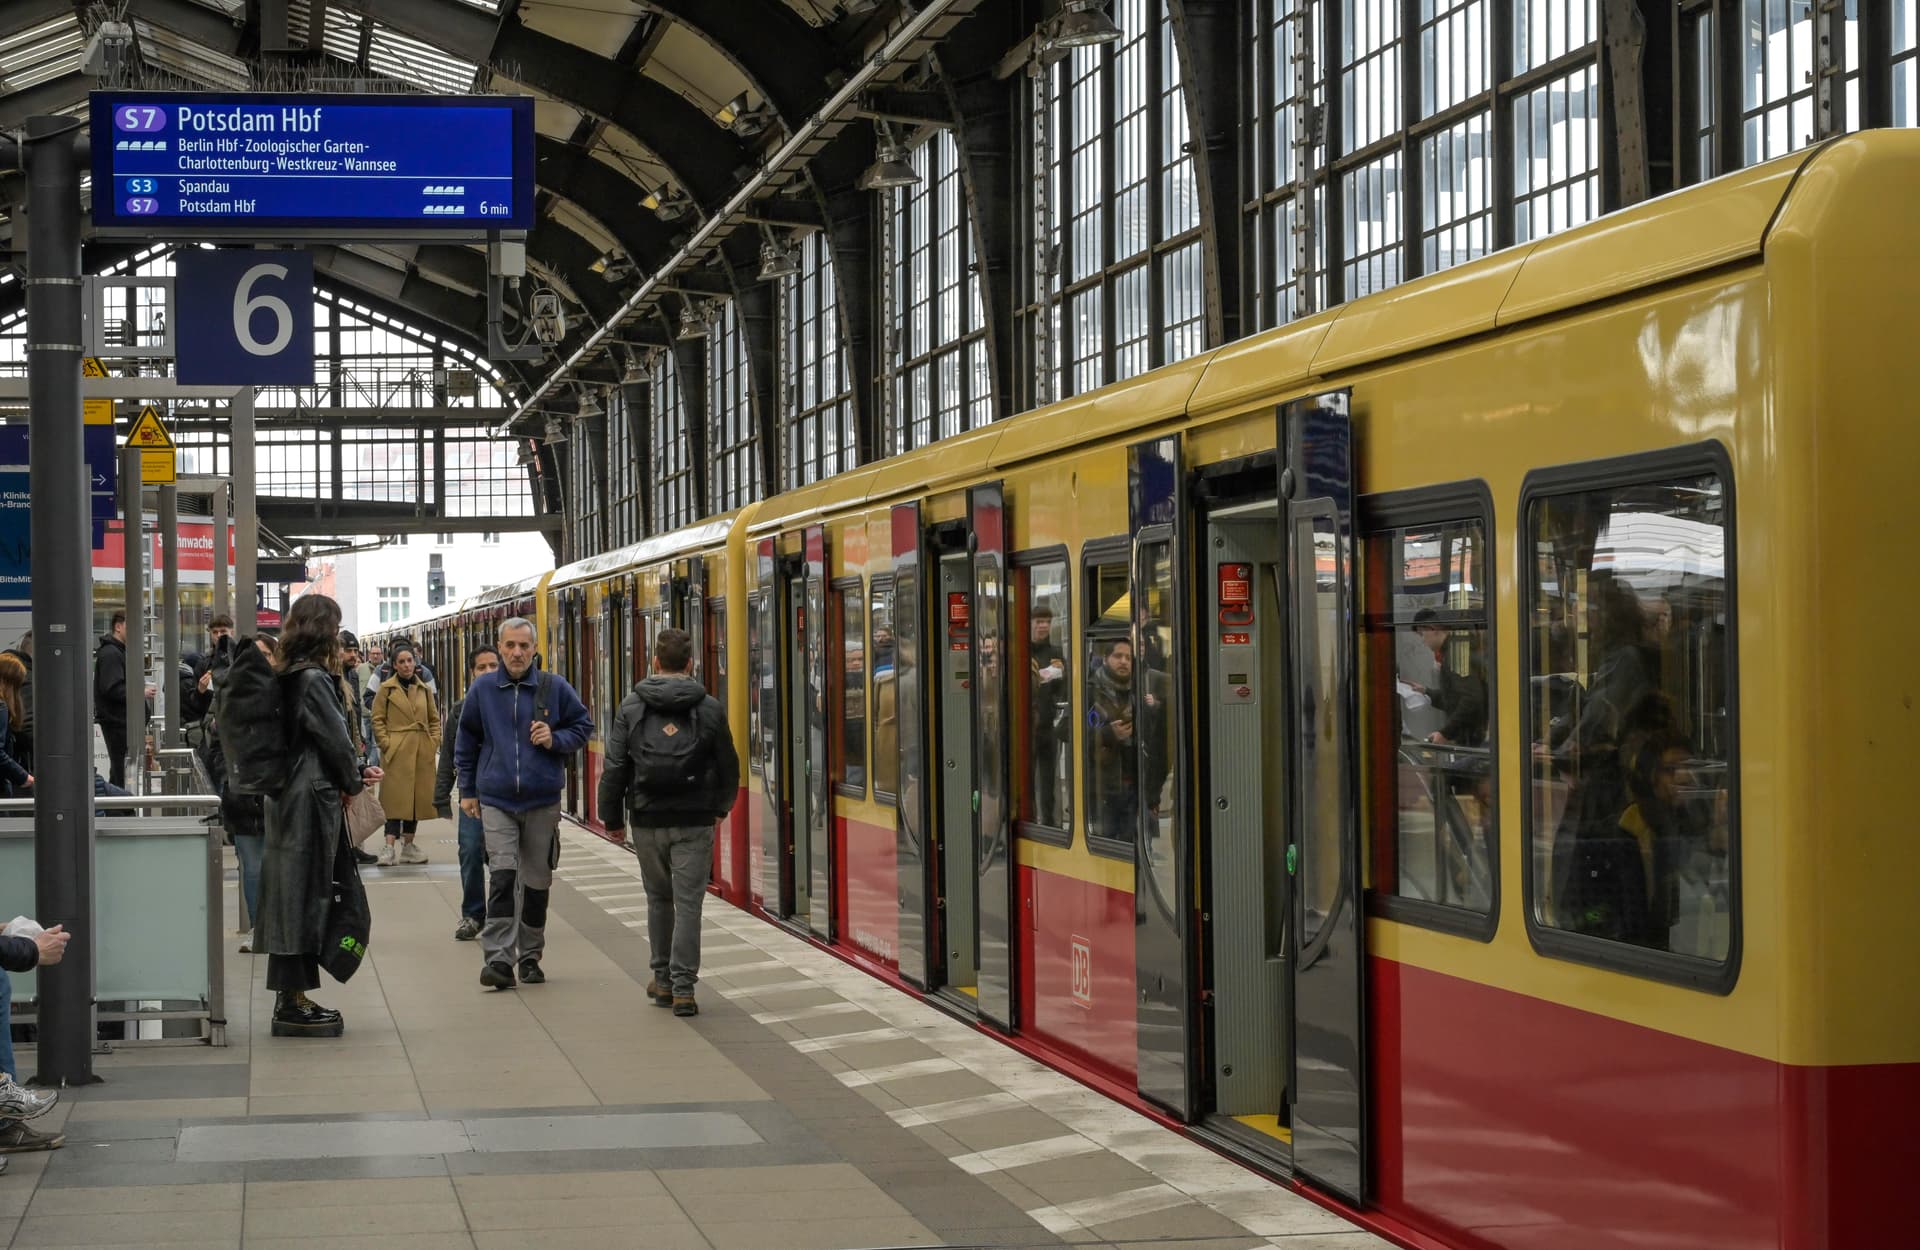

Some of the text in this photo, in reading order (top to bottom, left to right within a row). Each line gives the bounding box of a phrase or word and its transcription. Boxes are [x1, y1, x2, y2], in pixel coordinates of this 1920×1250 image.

[178, 106, 322, 132] Potsdam Hbf
[178, 137, 214, 152] Berlin
[323, 139, 370, 154] Garten-
[178, 178, 230, 196] Spandau
[179, 198, 256, 213] Potsdam Hbf
[479, 200, 509, 215] 6 min
[232, 263, 294, 356] 6
[1073, 948, 1089, 995] DB
